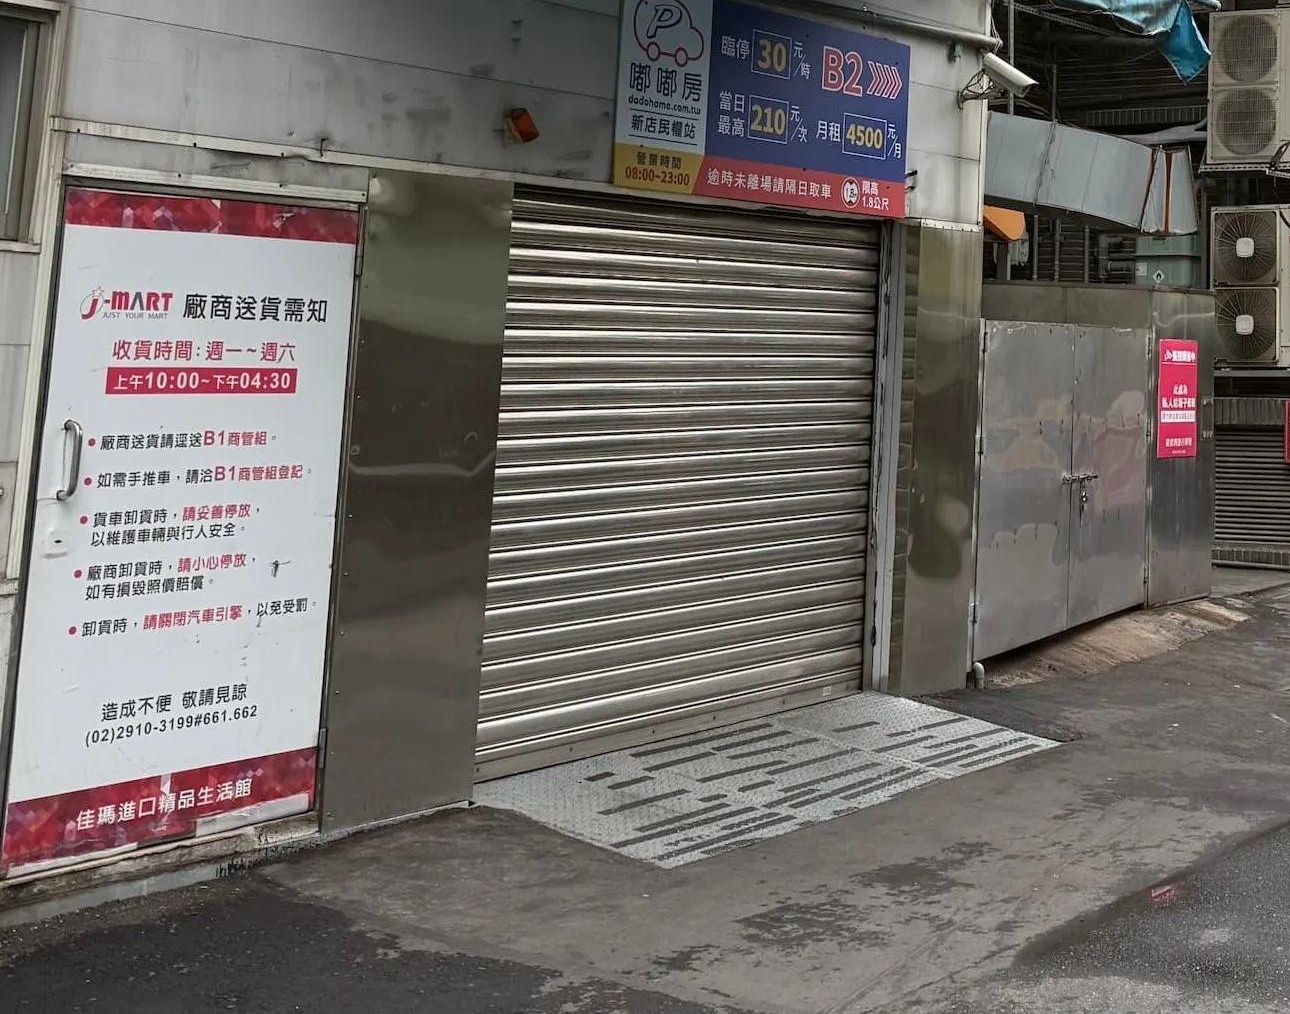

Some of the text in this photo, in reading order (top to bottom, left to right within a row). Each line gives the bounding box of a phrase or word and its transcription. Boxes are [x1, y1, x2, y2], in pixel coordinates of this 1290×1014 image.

[758, 39, 787, 72] 30
[821, 46, 863, 97] B2
[629, 62, 702, 102] 嘟嘟房
[631, 114, 696, 139] 新店民權站
[751, 104, 786, 135] 210
[816, 121, 841, 143] 月租
[846, 124, 883, 150] 4500
[637, 151, 682, 169] 營業時間
[707, 167, 832, 199] 逾時未離場請隔日取車
[183, 293, 328, 323] 廠商送貨需知
[101, 683, 247, 722] 造成不便 敬請見諒
[85, 705, 258, 747] (02)2910-3199#661.662
[76, 778, 252, 831] 佳瑪進口精品生活館
